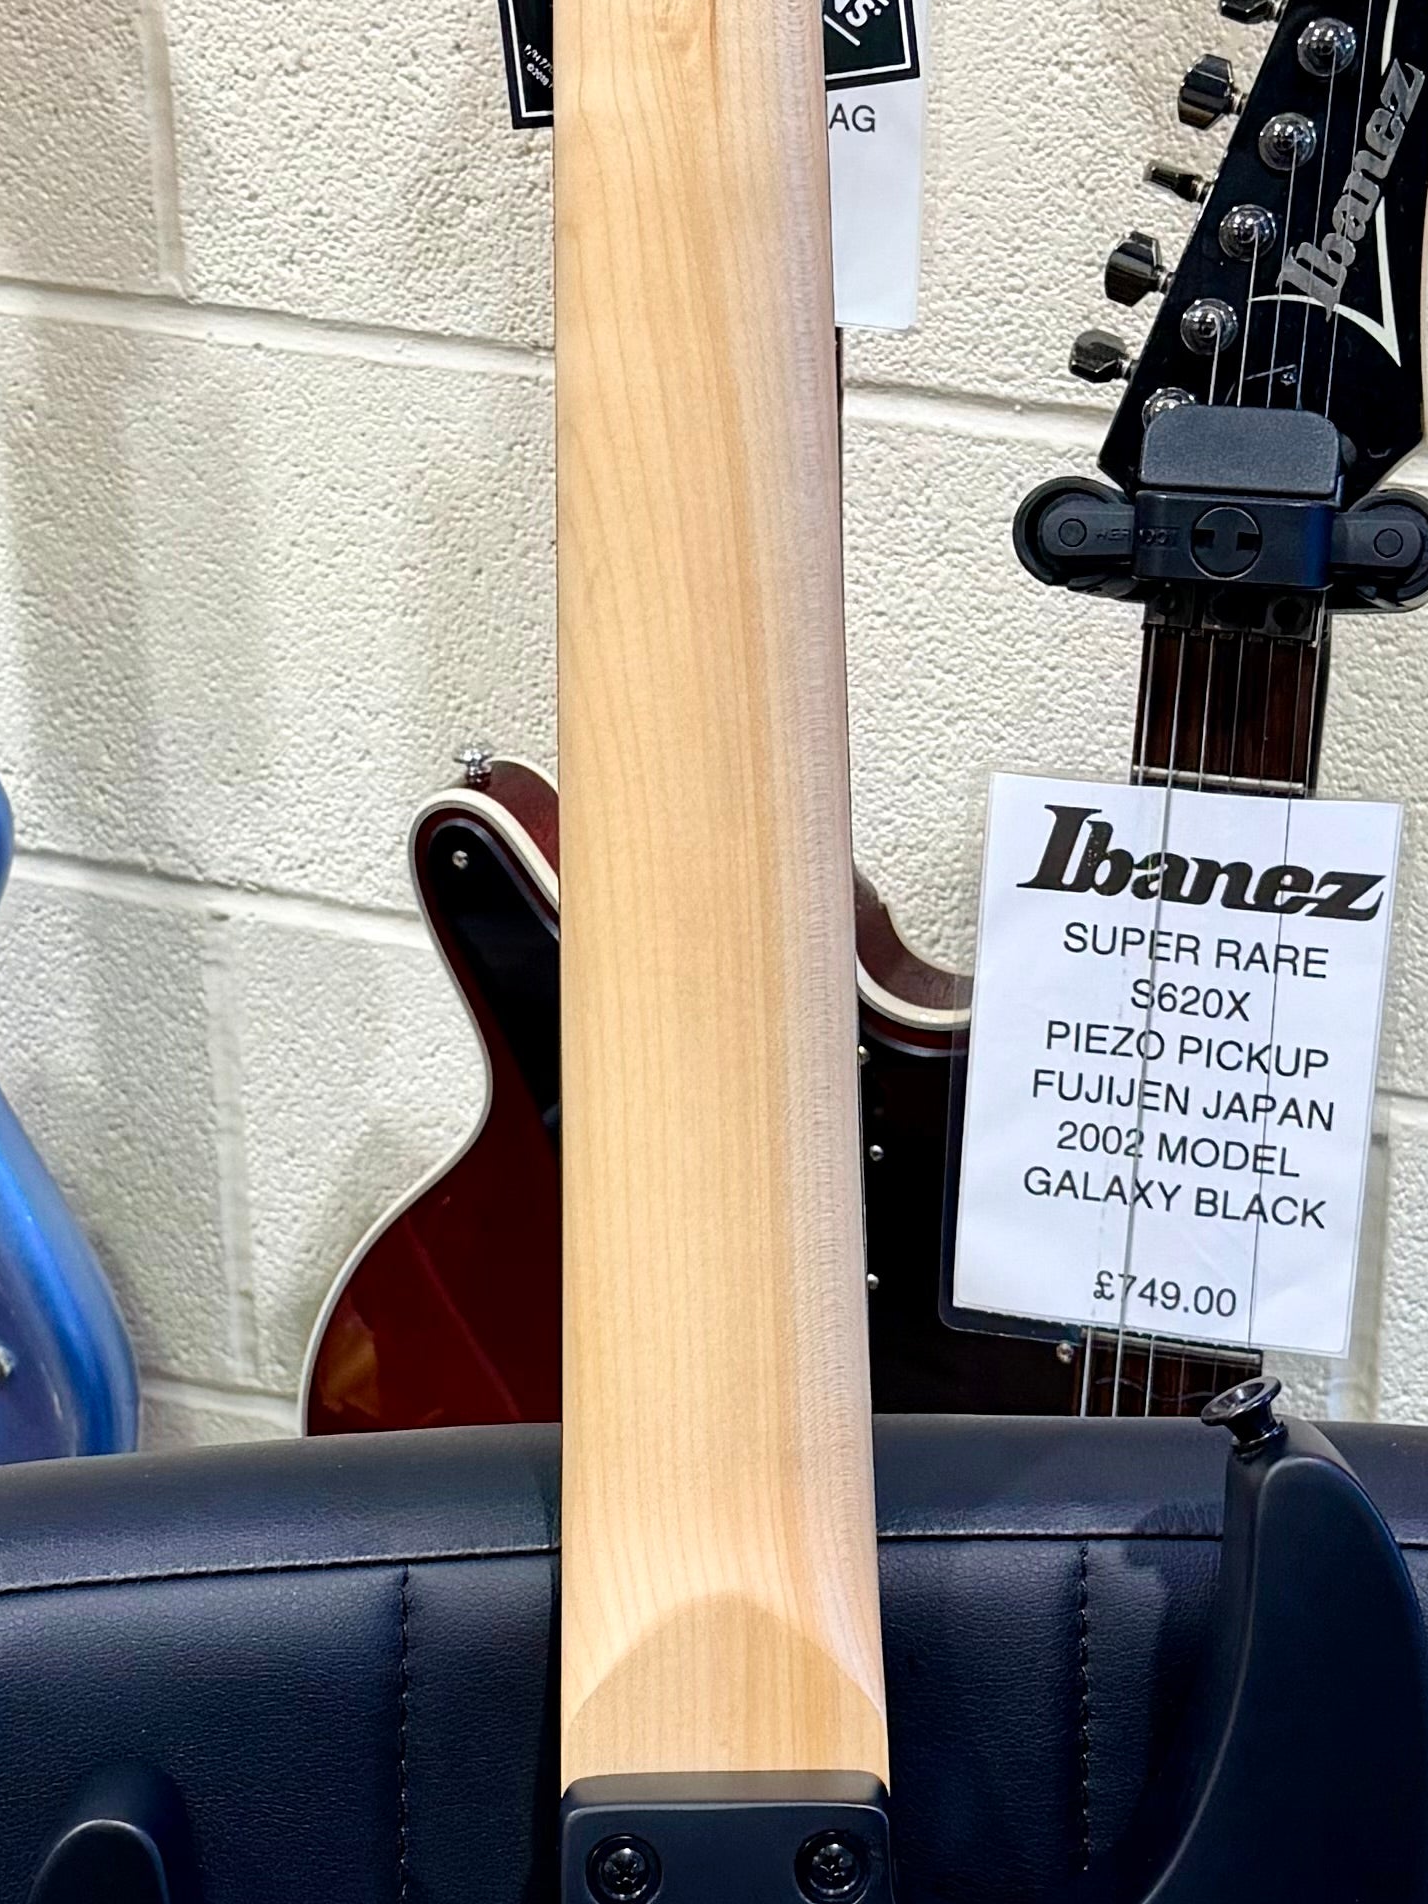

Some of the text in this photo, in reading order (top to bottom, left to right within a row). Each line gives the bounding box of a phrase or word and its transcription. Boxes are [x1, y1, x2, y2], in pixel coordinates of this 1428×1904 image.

[1278, 57, 1427, 321] Ibanez
[1016, 802, 1387, 922] Ibanez
[1063, 922, 1331, 981] SUPER RARE
[1131, 978, 1252, 1023] S620X
[1046, 1020, 1330, 1080] PIEZO PICKUP
[1031, 1069, 1336, 1132] FUJIJEN JAPAN
[1056, 1120, 1301, 1179] 2002 MODEL
[1022, 1165, 1328, 1230] GALAXY BLACK
[1092, 1269, 1239, 1320] £749.00
